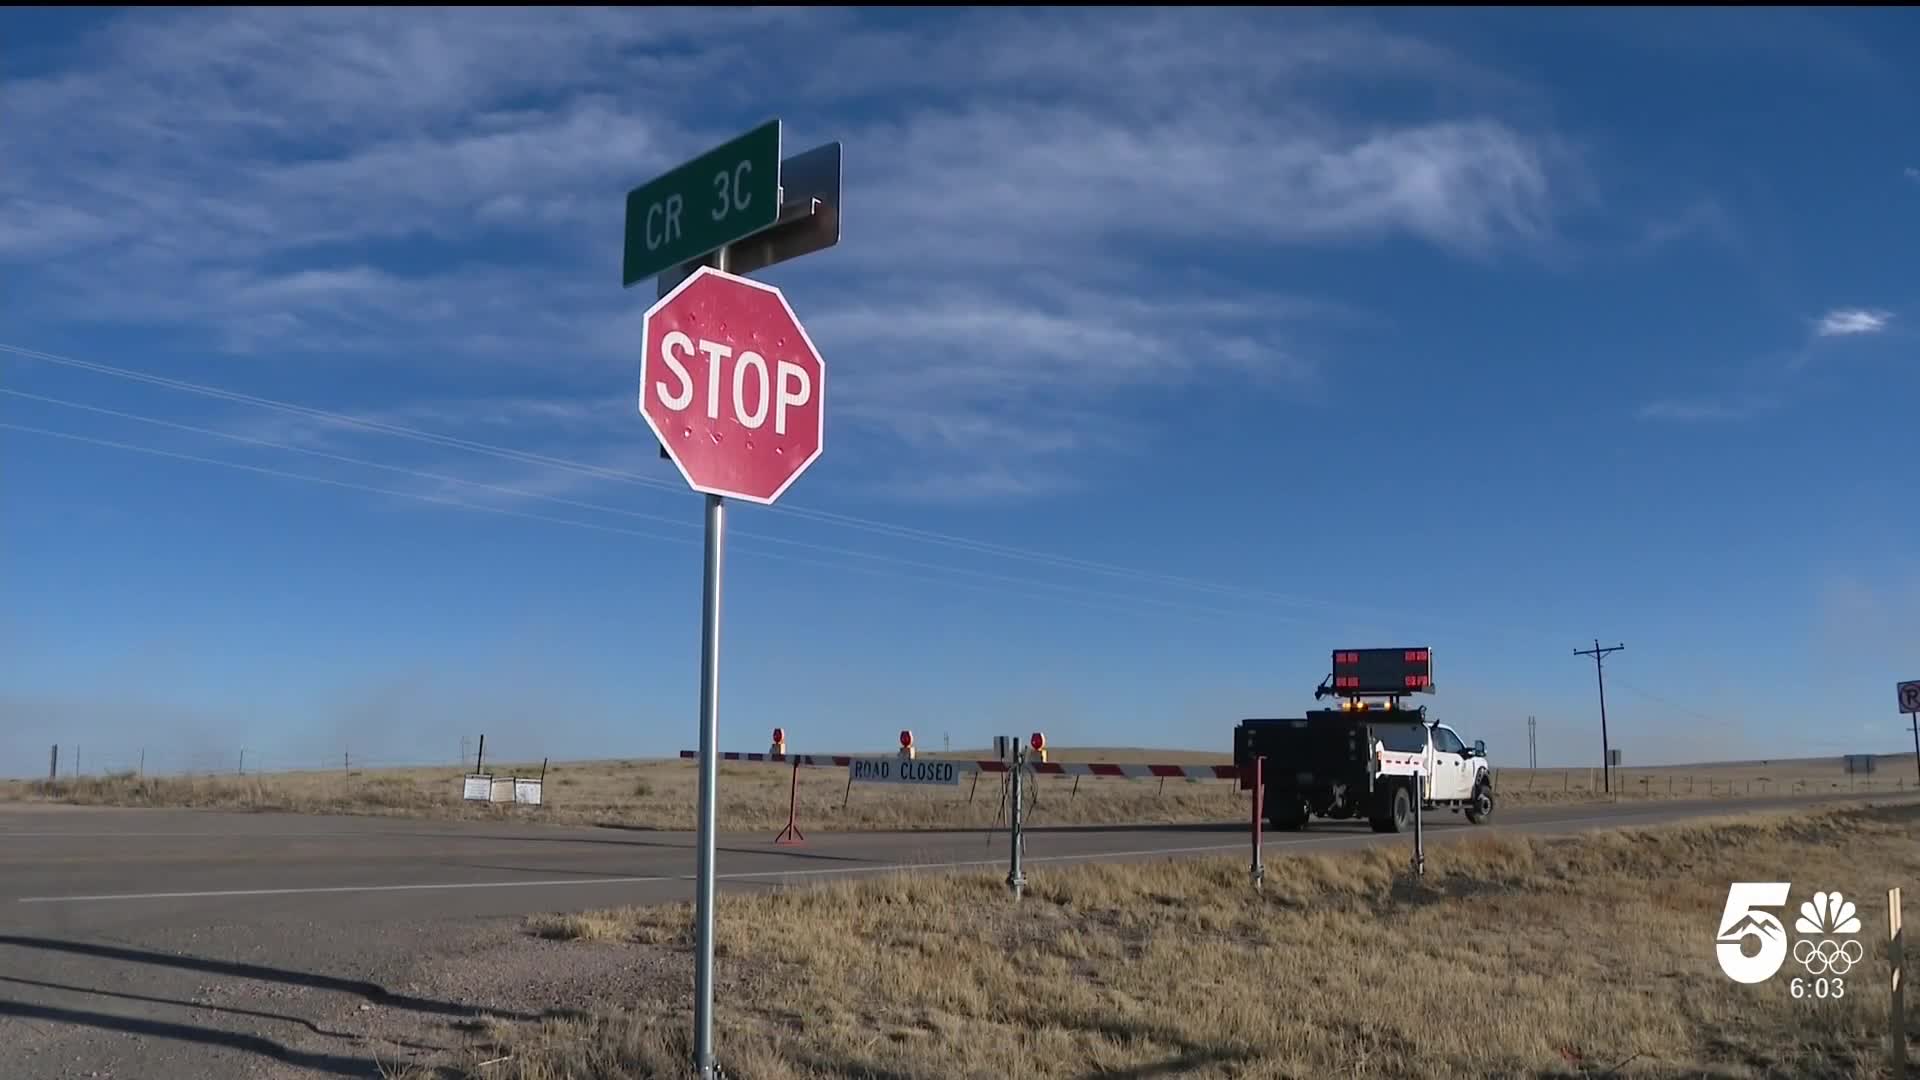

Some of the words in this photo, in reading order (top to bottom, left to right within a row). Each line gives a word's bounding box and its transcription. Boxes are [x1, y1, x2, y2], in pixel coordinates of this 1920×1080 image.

[645, 193, 682, 251] CR
[711, 160, 752, 222] 3C
[656, 330, 811, 435] STOP
[855, 761, 889, 778] ROAD
[900, 762, 953, 781] CLOSED
